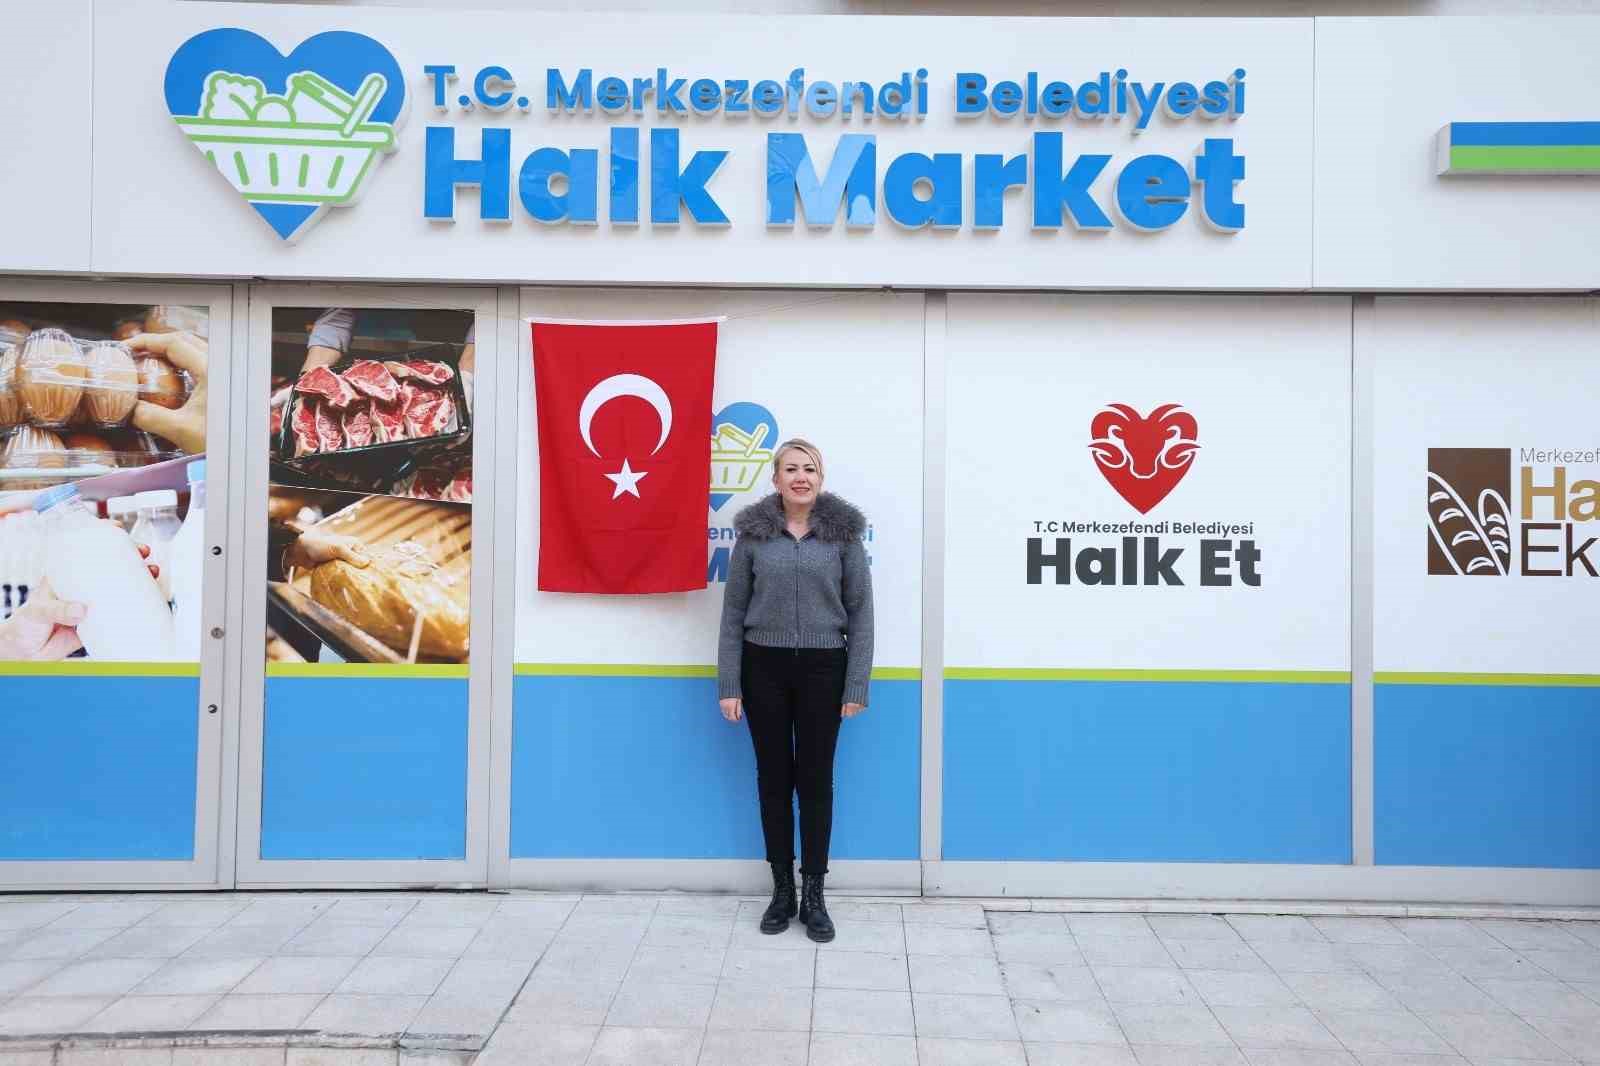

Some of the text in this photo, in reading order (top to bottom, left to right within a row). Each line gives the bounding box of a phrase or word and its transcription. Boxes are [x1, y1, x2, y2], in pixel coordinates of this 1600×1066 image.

[424, 65, 1246, 135] T.C. Merkezefendi Belediyesi
[424, 126, 1246, 230] Halk Market
[1033, 521, 1254, 538] T.C Merkezefendi Belediyesi
[1026, 536, 1262, 587] Halk Et
